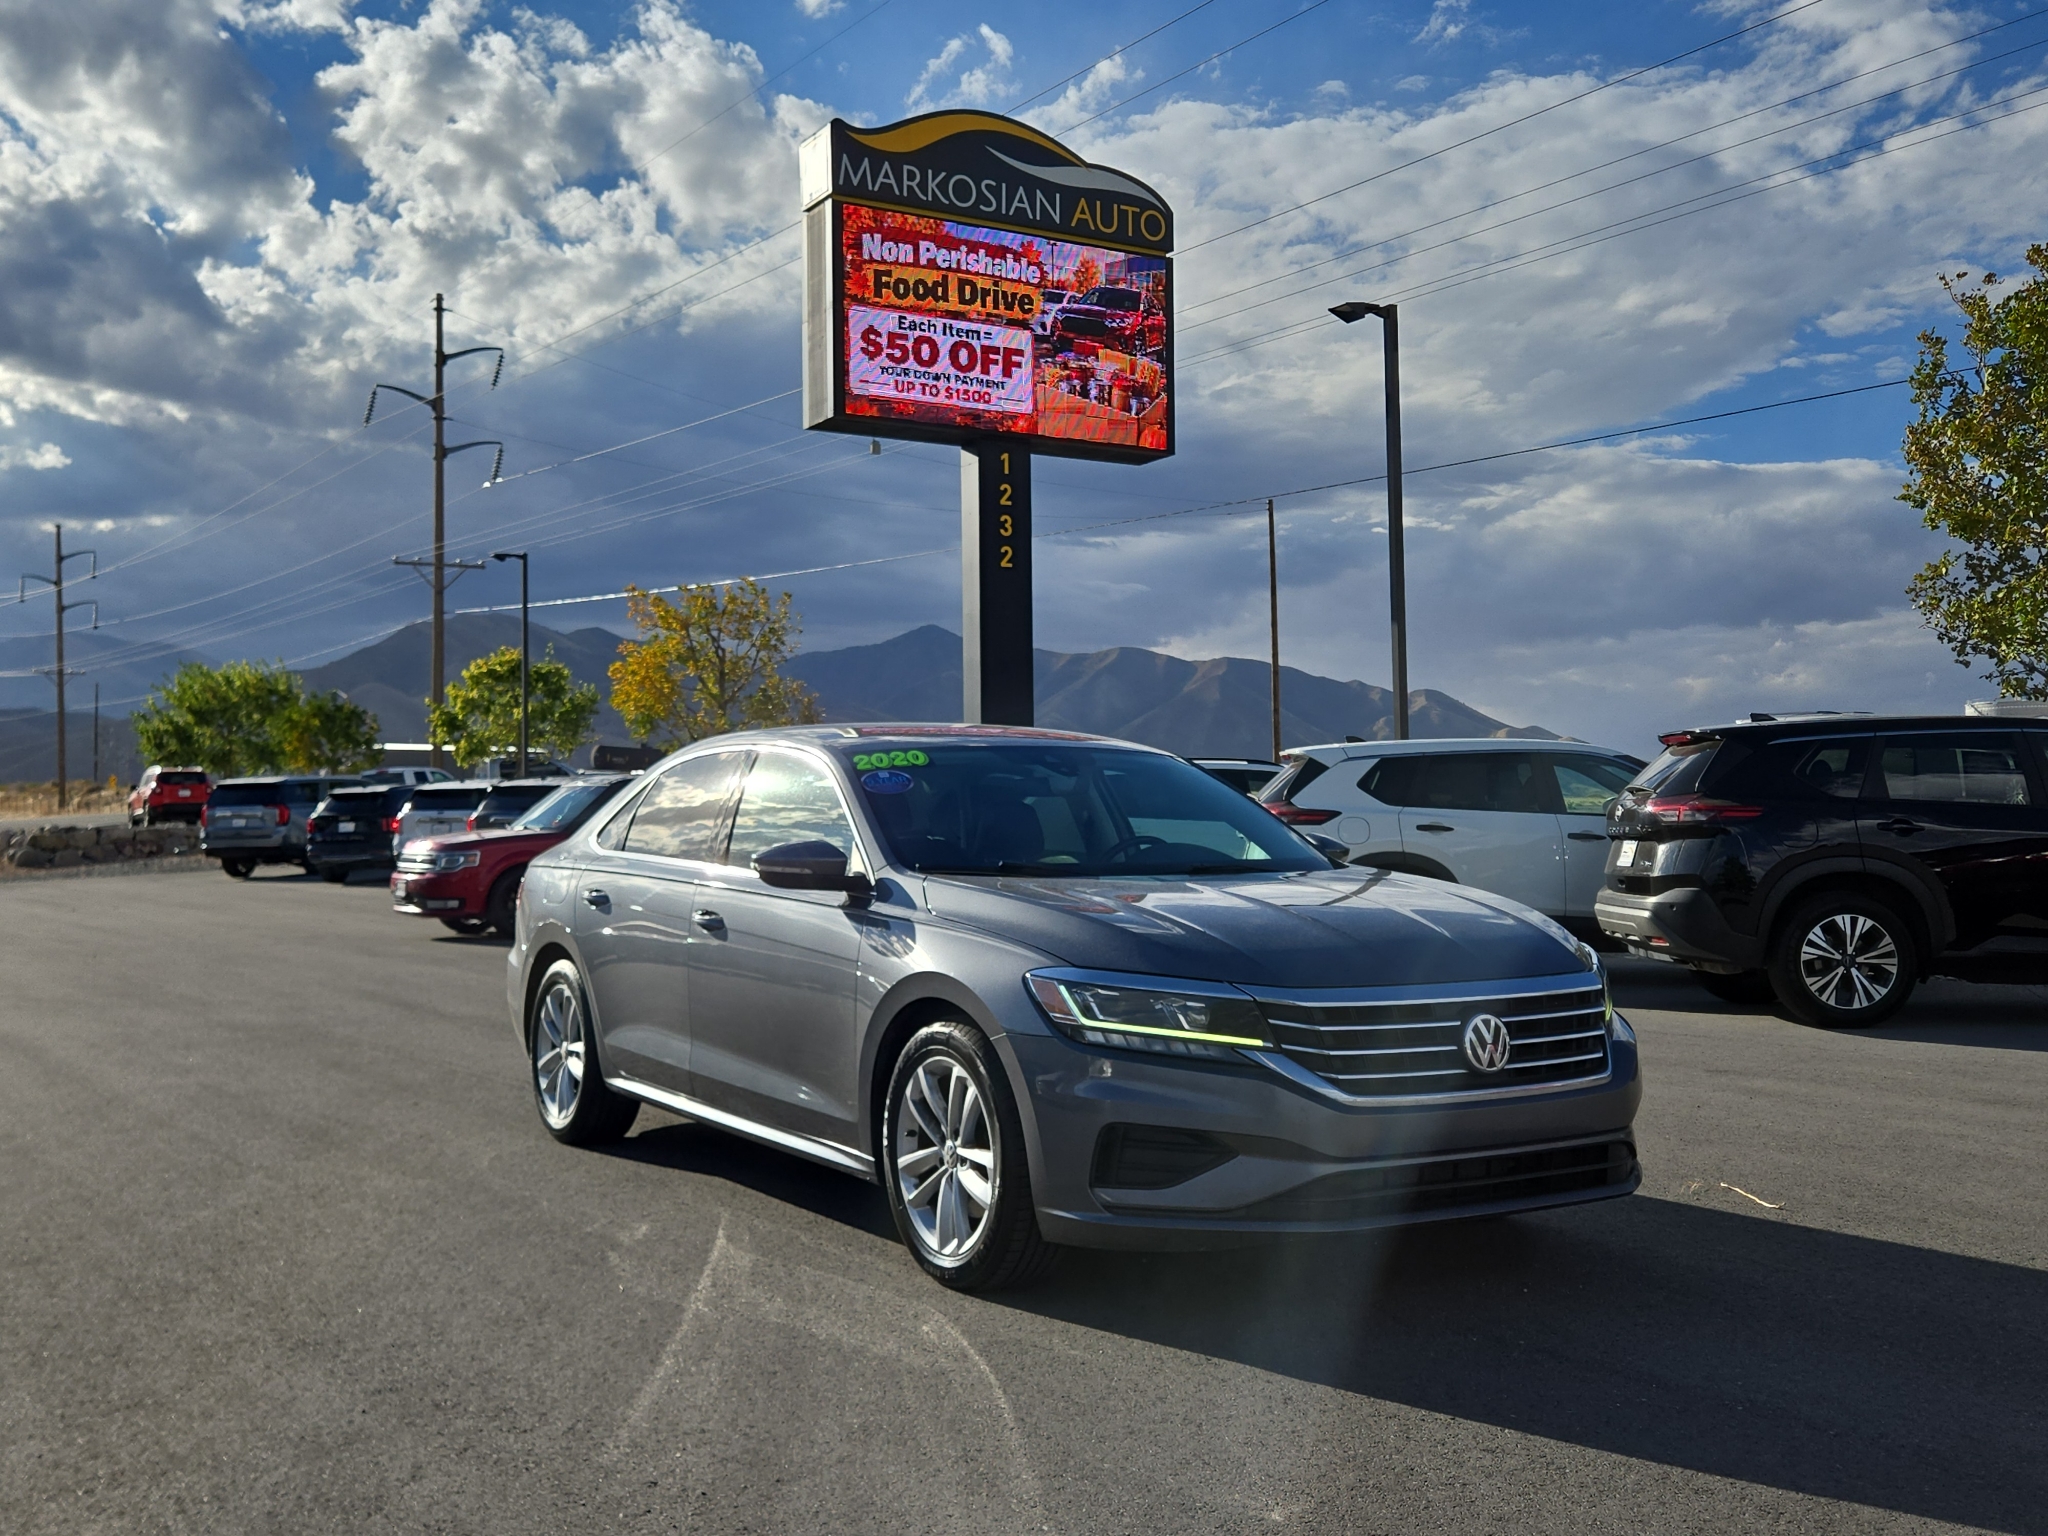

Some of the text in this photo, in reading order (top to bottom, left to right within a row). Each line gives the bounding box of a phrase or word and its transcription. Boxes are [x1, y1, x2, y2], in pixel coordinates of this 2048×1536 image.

[838, 153, 1165, 241] MARKOSIAN AUTO
[862, 234, 1041, 284] Non Perishable
[873, 269, 1034, 315] Food Drive
[898, 315, 937, 334] Each
[860, 325, 1024, 379] $50 OFF
[880, 366, 911, 378] YOUR
[954, 374, 1006, 390] PAYMENT
[894, 380, 992, 404] UP TO $1500
[853, 750, 929, 770] 2020
